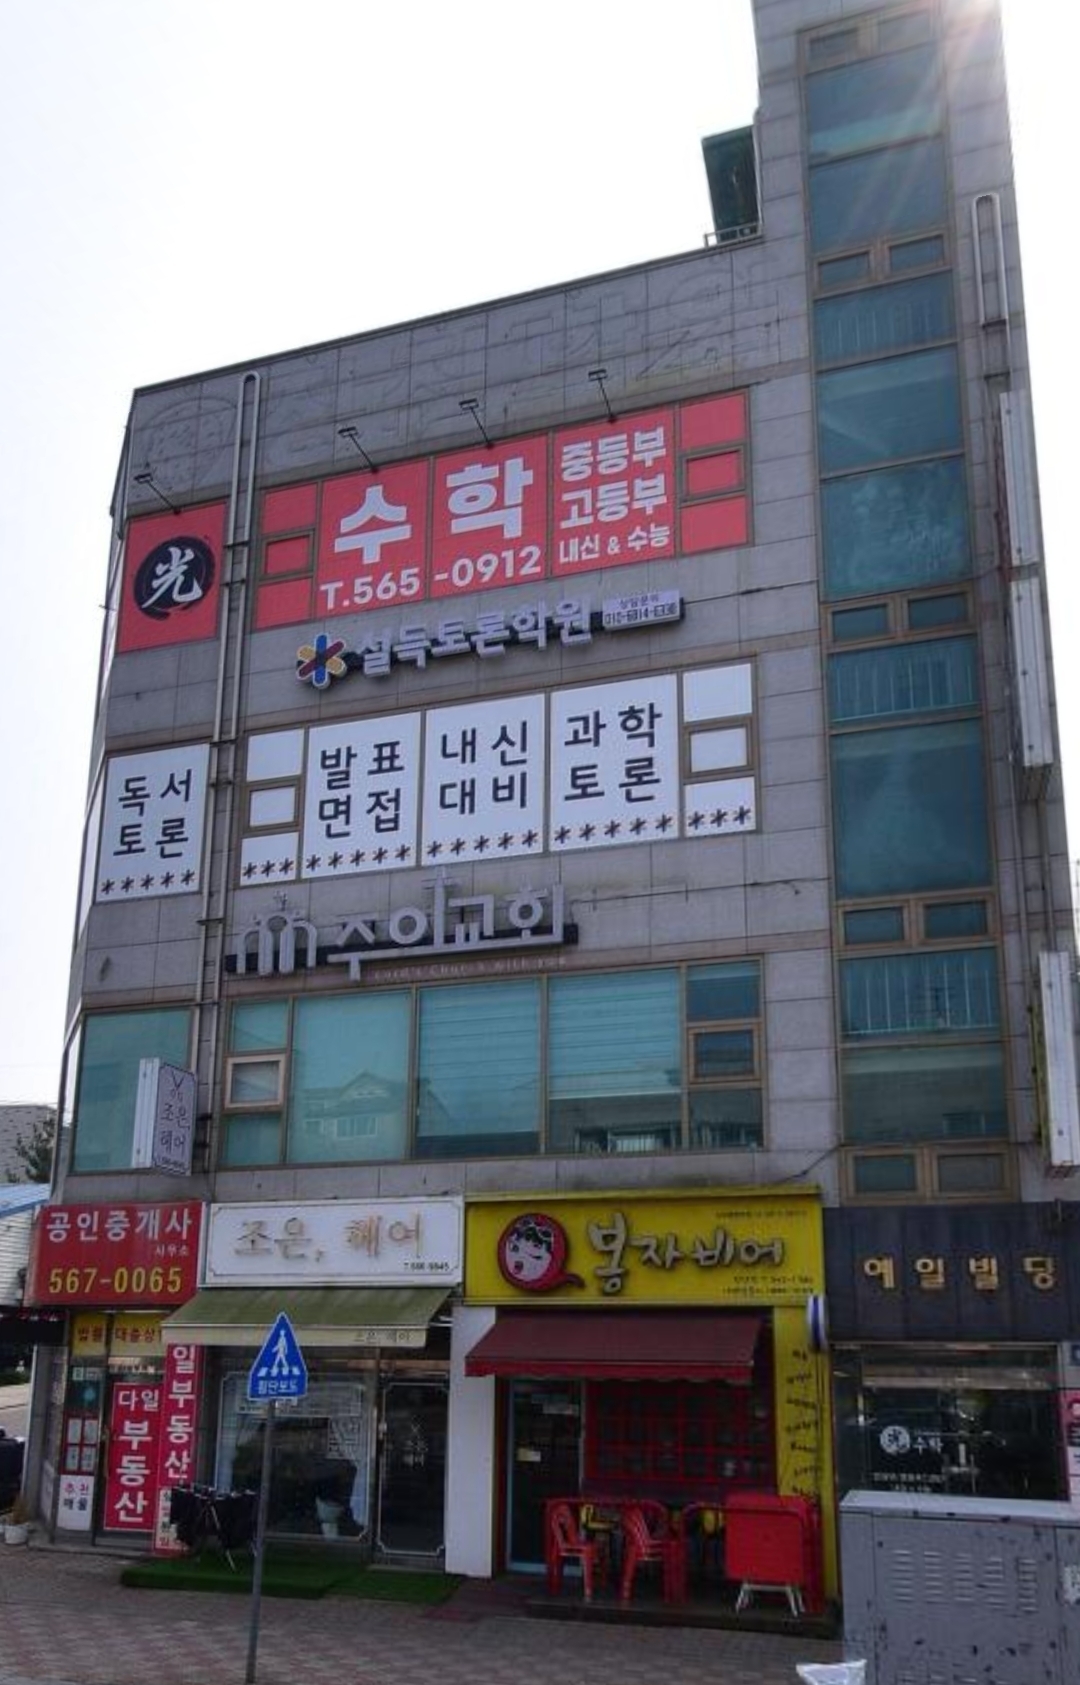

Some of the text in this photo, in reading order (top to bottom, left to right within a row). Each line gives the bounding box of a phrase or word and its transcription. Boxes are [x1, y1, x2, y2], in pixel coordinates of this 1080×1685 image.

[561, 427, 668, 482] 중등부
[334, 455, 533, 563] 수학
[559, 474, 668, 529] 고등부
[559, 523, 671, 565] 내신 & 수능
[356, 595, 592, 678] 설득토론학원
[441, 719, 528, 765] 내신
[565, 703, 662, 749] 과학
[321, 740, 405, 788] 발표
[564, 758, 661, 803] 토론
[118, 769, 192, 817] 독서
[319, 787, 402, 840] 면접
[439, 770, 528, 815] 대비
[113, 817, 190, 858] 토론
[47, 1208, 192, 1242] 공인중개사
[345, 1210, 423, 1259] 헤어
[585, 1210, 785, 1296] 봉자비어
[863, 1255, 1059, 1292] 예일빌딩
[49, 1267, 181, 1294] 567-0065
[118, 1389, 159, 1412] 다일
[258, 1380, 298, 1395] 횡단보도
[114, 1420, 152, 1523] 부동산
